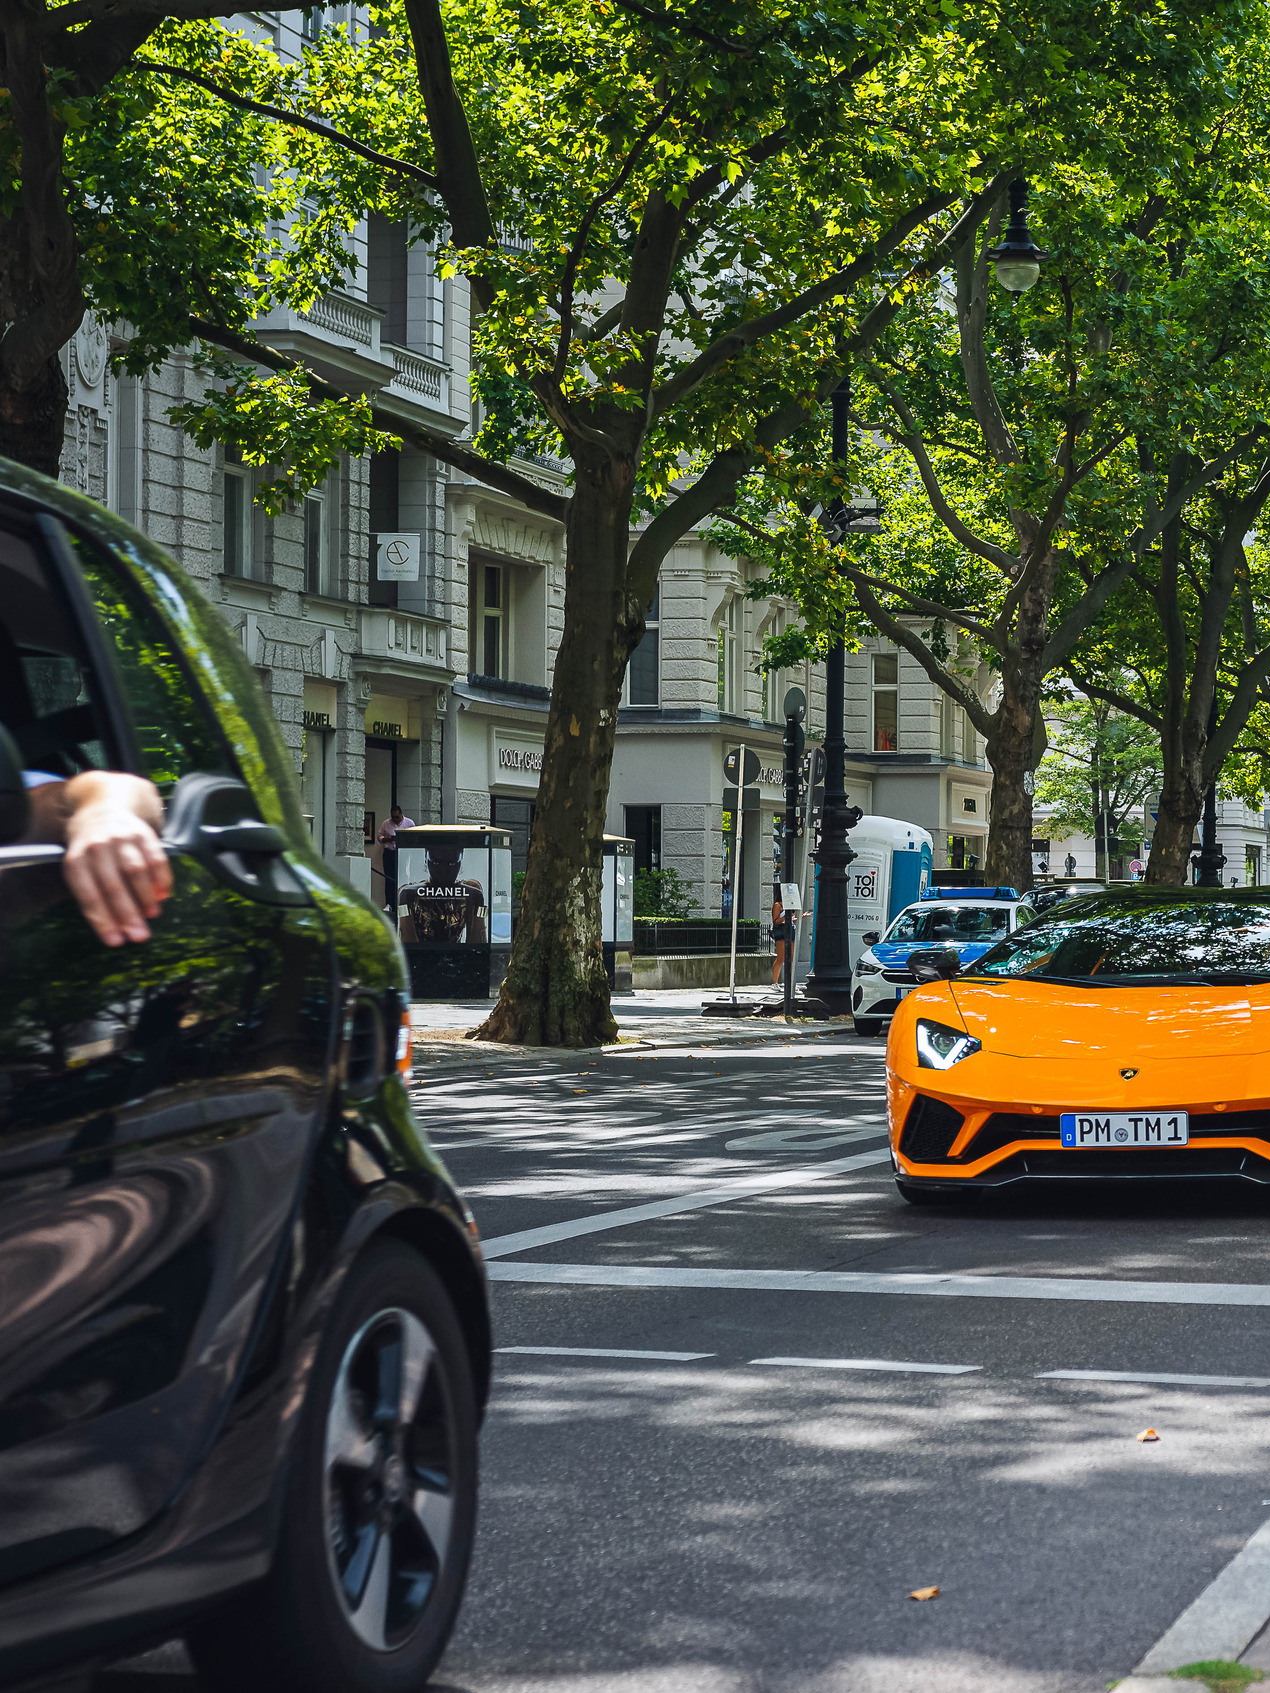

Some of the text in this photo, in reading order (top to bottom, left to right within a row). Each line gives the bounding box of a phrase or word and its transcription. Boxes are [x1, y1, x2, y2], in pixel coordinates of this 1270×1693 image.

[303, 710, 331, 728] HANEL
[373, 720, 403, 737] CHANEL
[500, 748, 521, 768] DOLCE
[524, 751, 542, 770] GABB
[855, 875, 874, 886] TOI
[417, 887, 470, 896] CHANEL
[854, 887, 874, 897] TOI
[1078, 1118, 1111, 1142] PM
